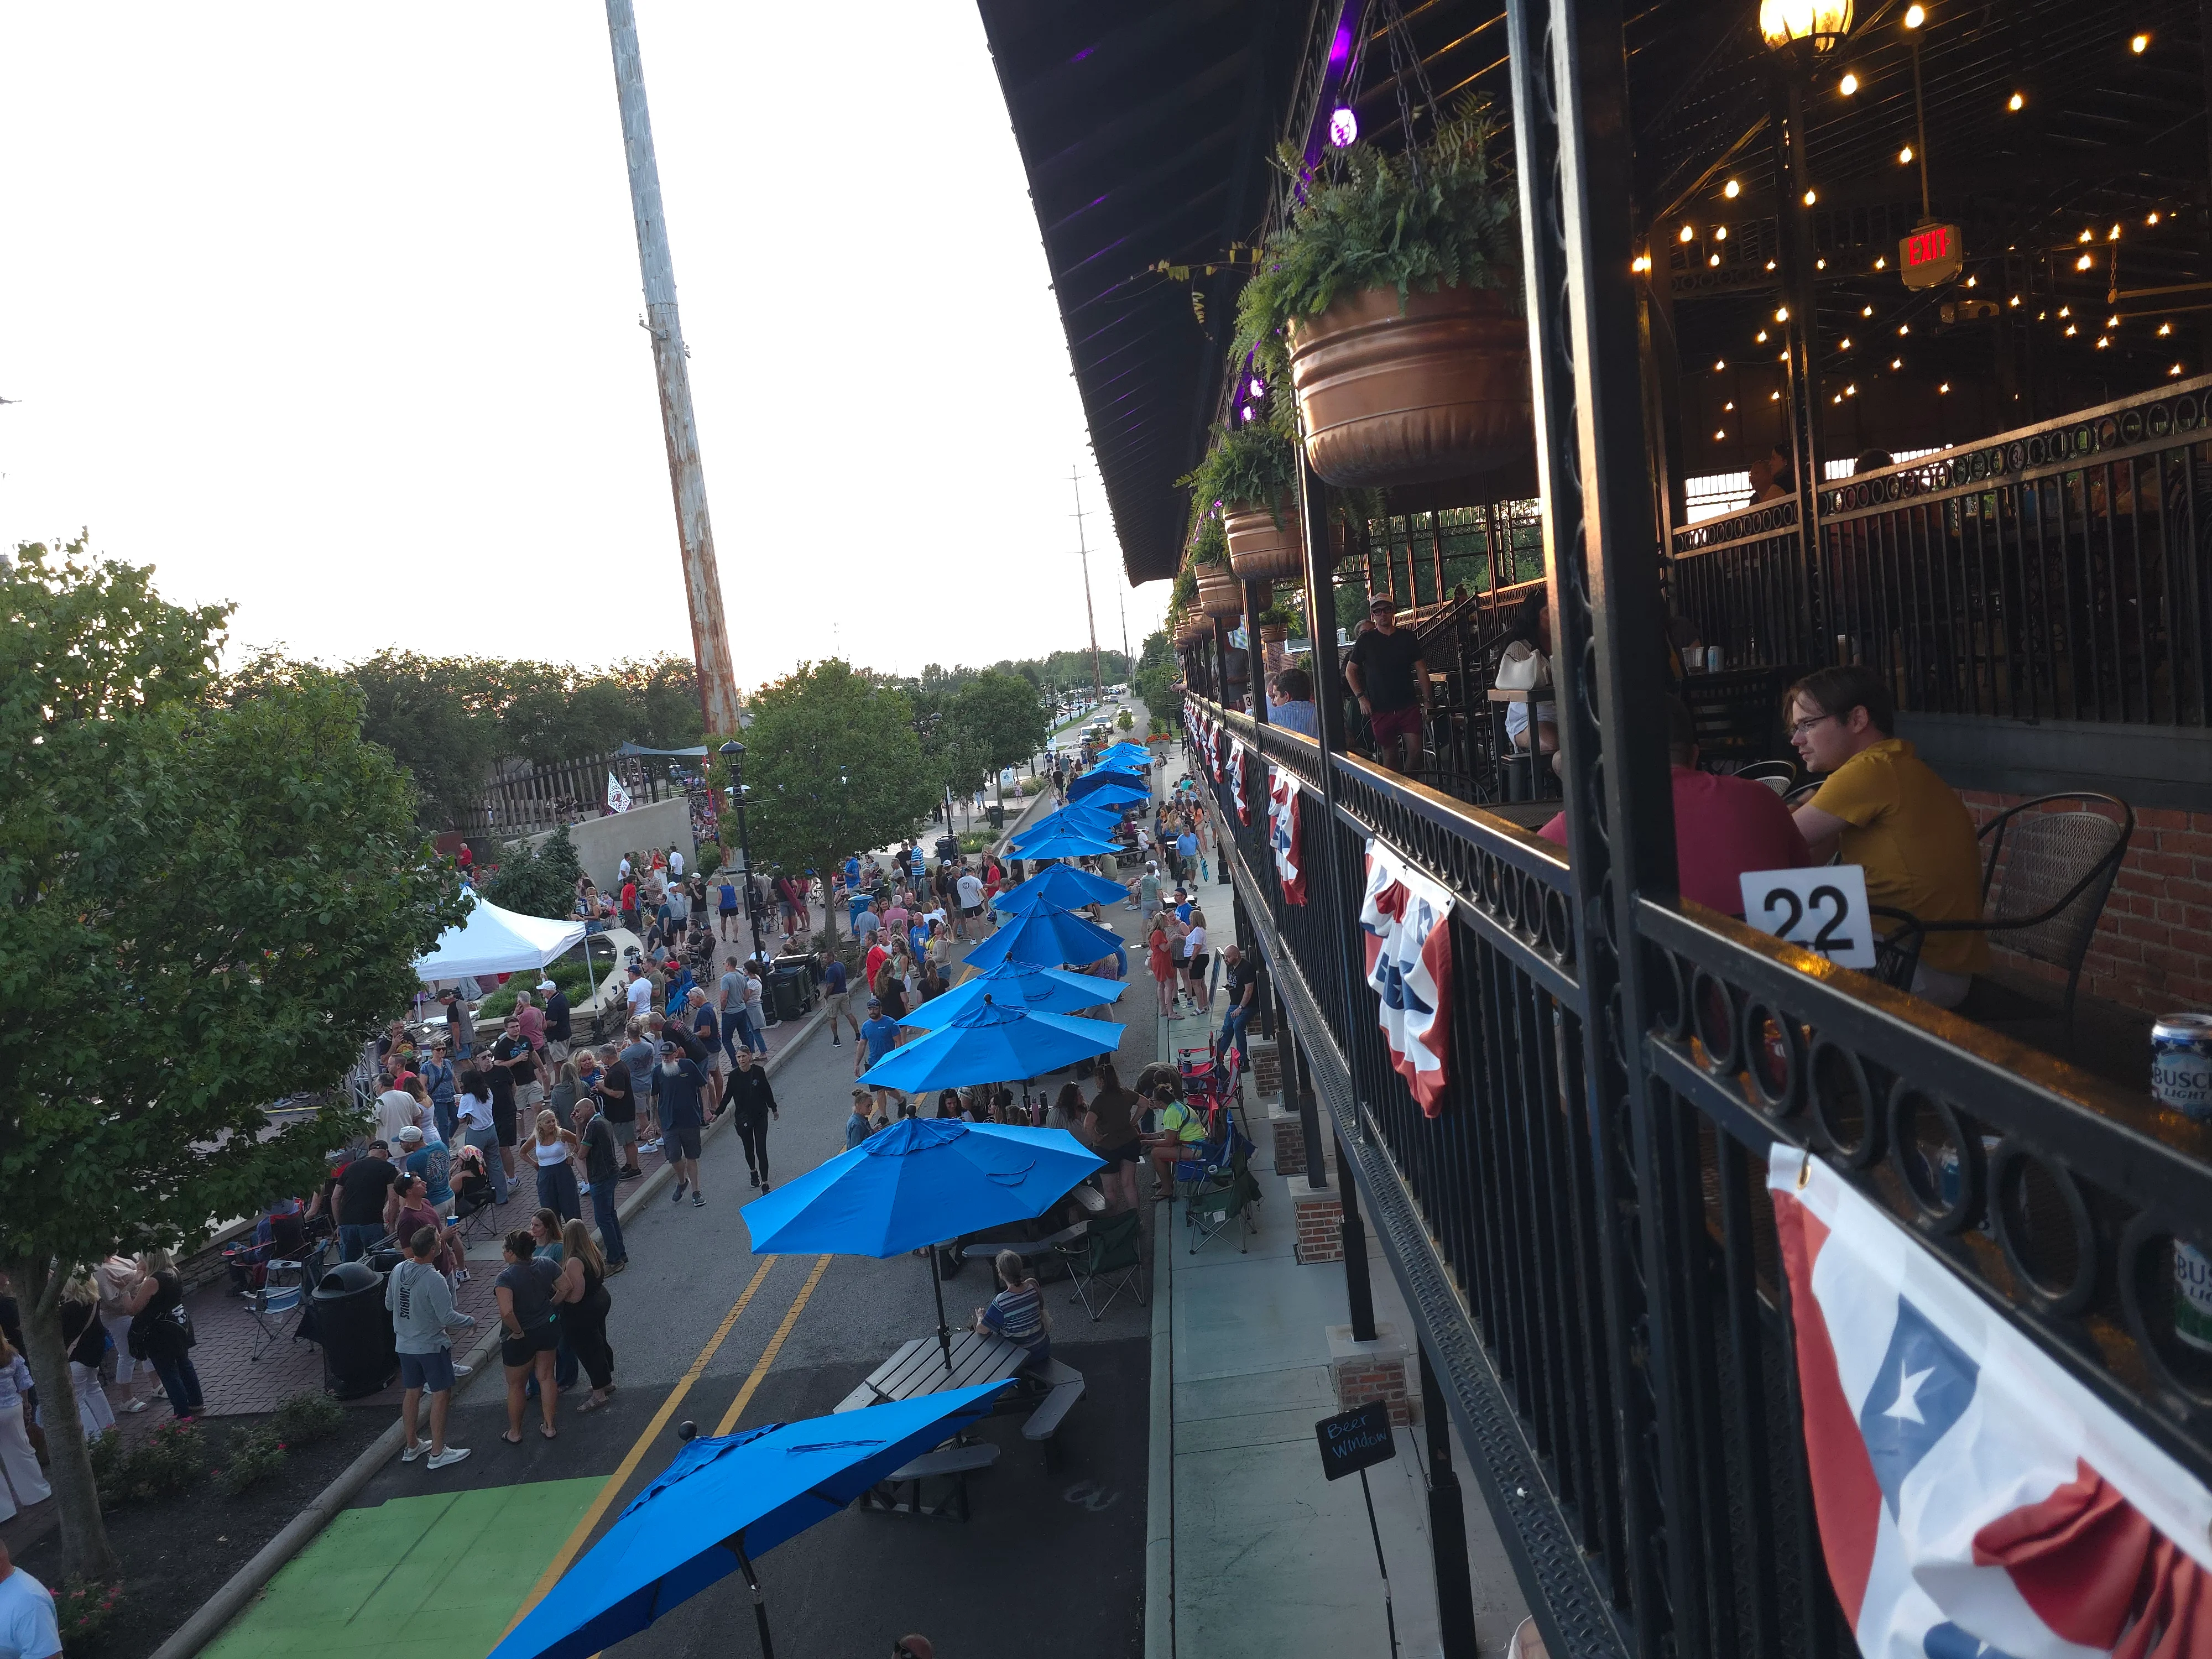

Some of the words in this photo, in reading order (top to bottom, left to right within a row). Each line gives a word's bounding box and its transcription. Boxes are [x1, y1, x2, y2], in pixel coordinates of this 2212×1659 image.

[1908, 228, 1947, 265] EXIT
[1246, 696, 1253, 706] 3
[1764, 885, 1854, 950] 22
[2164, 1088, 2207, 1100] LIGHT
[2178, 1254, 2212, 1287] BU
[1327, 1415, 1368, 1439] Beer
[1332, 1428, 1387, 1459] Window
